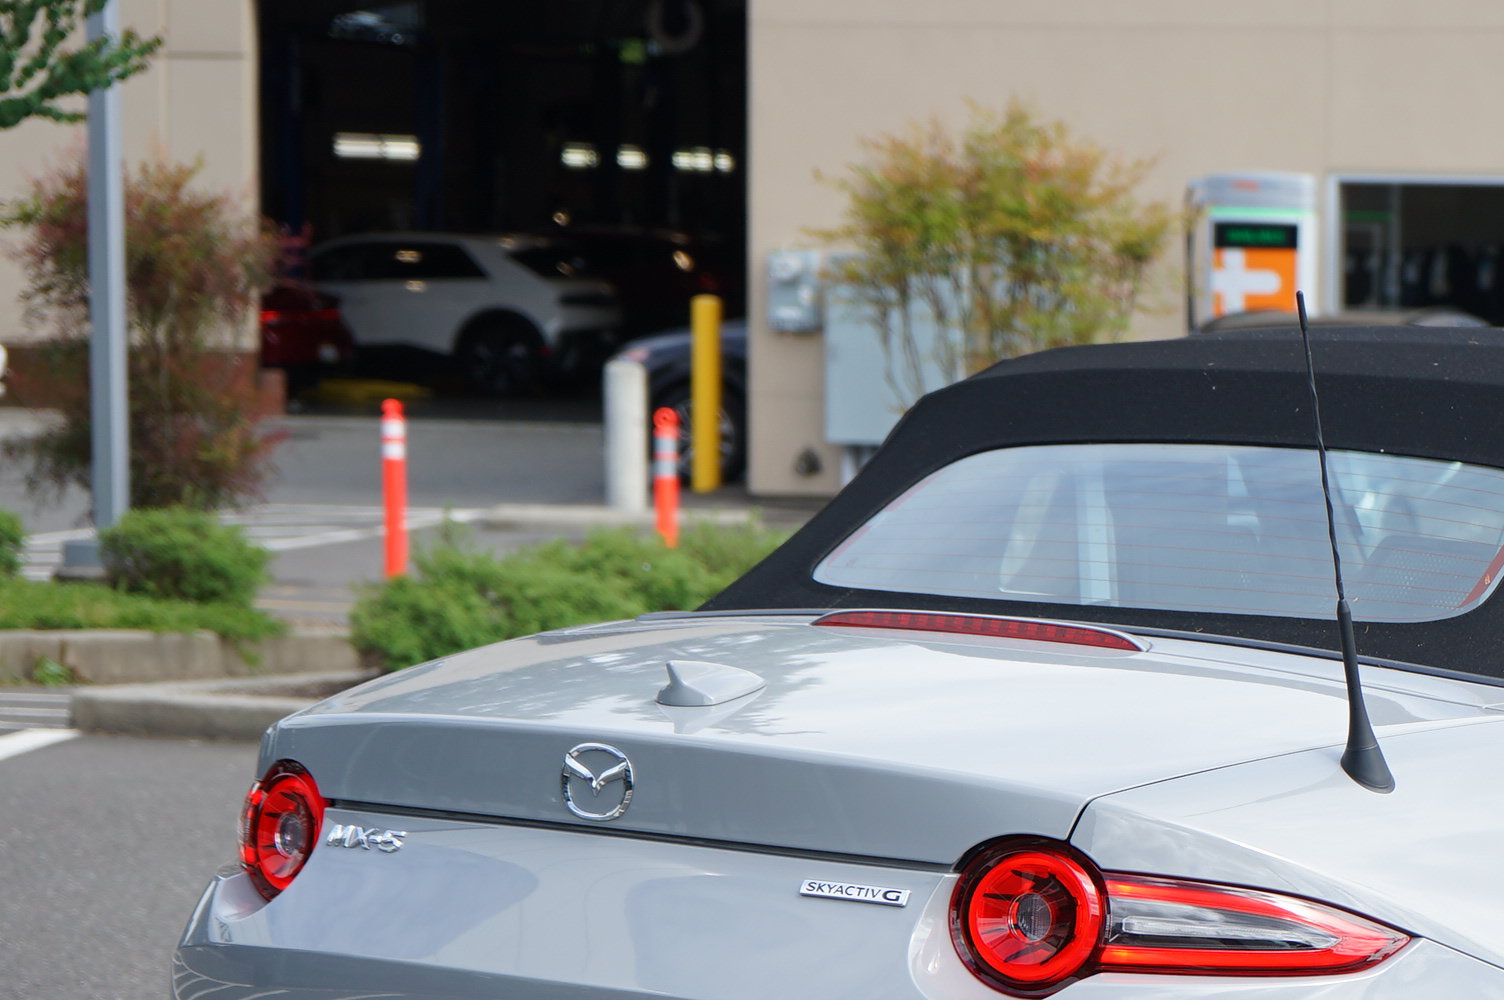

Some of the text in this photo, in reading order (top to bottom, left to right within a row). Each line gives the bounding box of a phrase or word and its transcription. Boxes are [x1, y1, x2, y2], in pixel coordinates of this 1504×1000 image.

[327, 824, 407, 853] MX-5
[806, 881, 902, 902] SKYACTIV G
